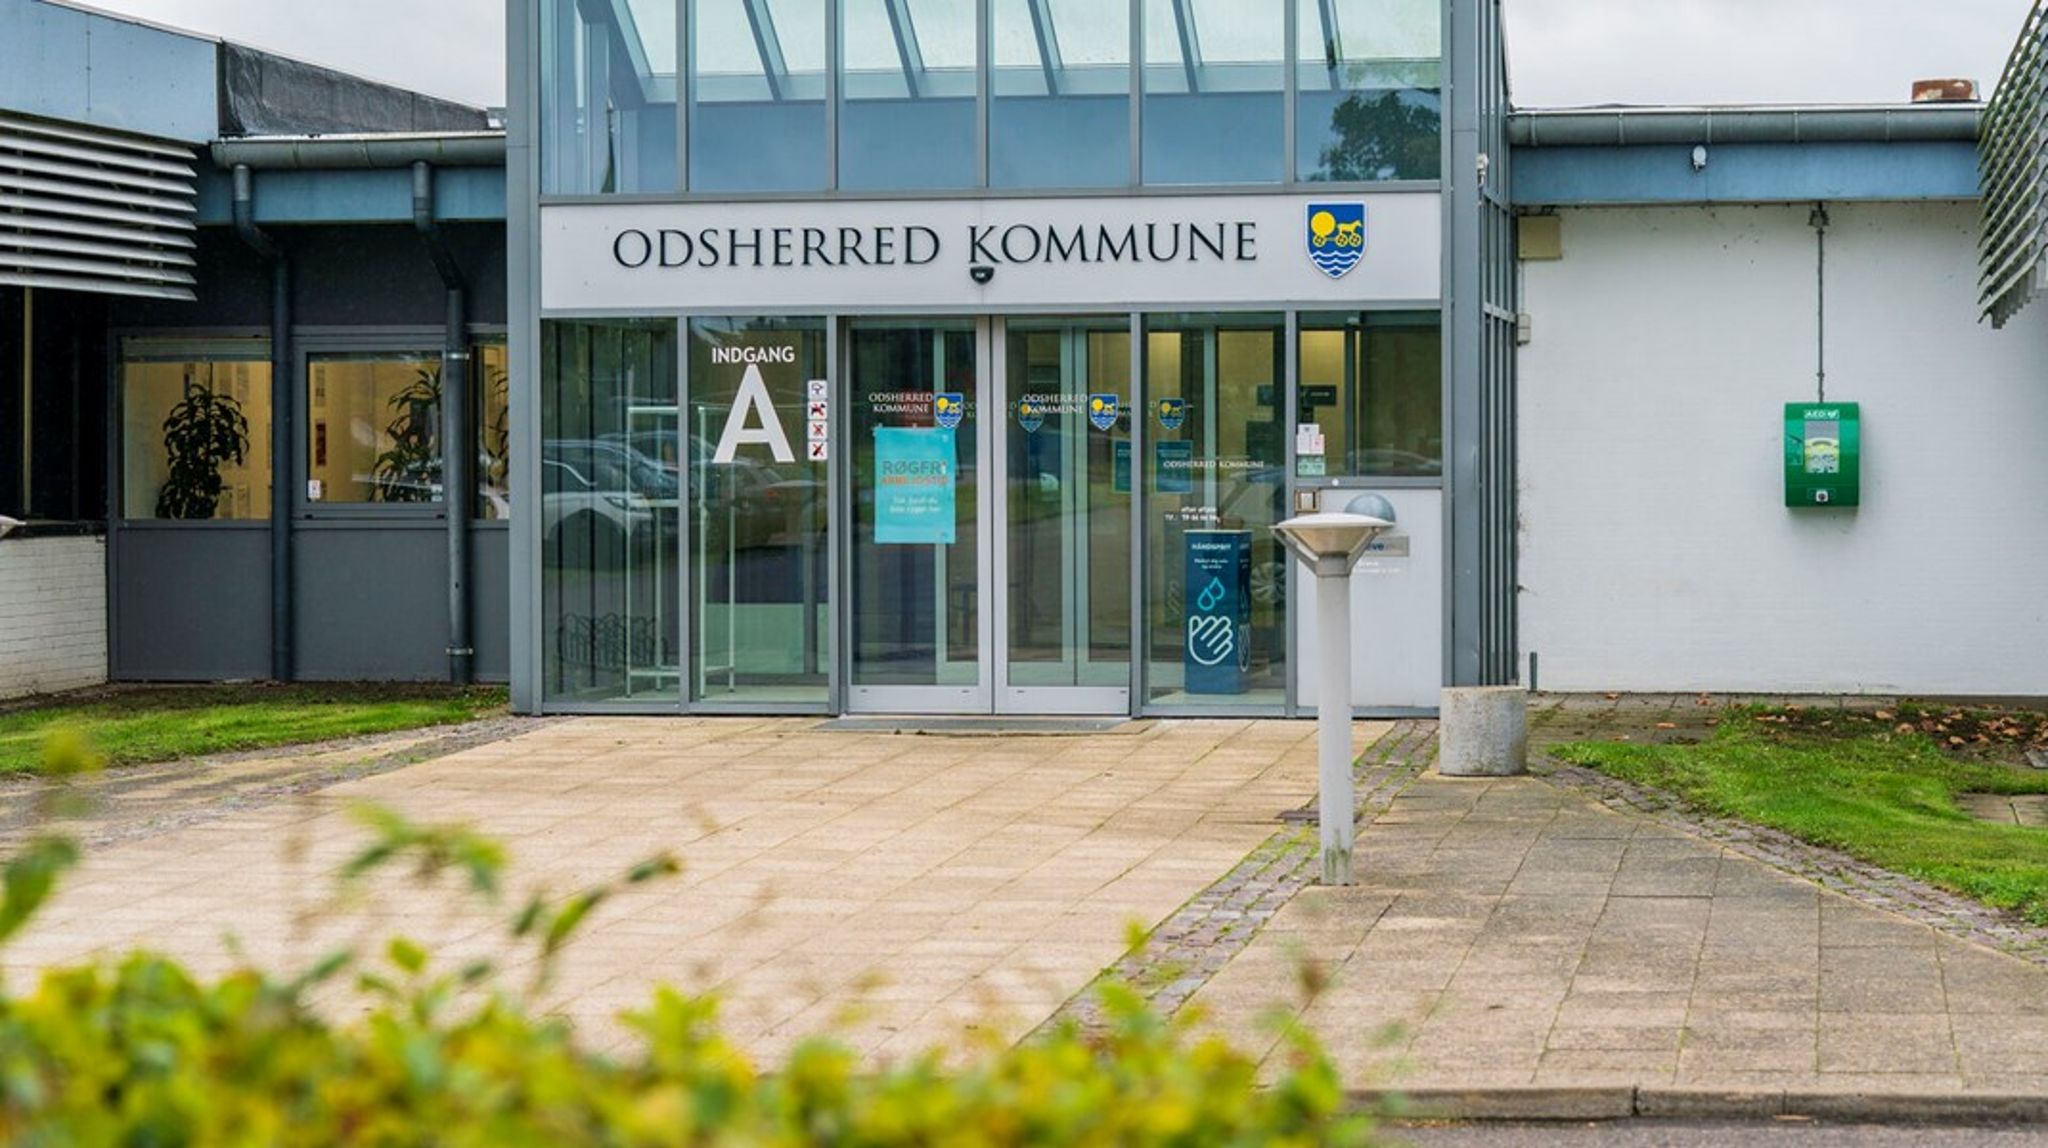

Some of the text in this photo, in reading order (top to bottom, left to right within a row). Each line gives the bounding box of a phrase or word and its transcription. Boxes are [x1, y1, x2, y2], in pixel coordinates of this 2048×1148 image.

[613, 222, 1257, 268] ODSHERRED KOMMUNE
[712, 346, 795, 363] INDGANG
[869, 392, 933, 402] ODSHERRED
[1023, 393, 1088, 403] ODSHERRED
[712, 363, 796, 463] A
[873, 403, 929, 413] KOMMUNE
[1027, 404, 1084, 414] KOMMUNE
[1163, 461, 1264, 469] ODSHERRED KOMMUNE
